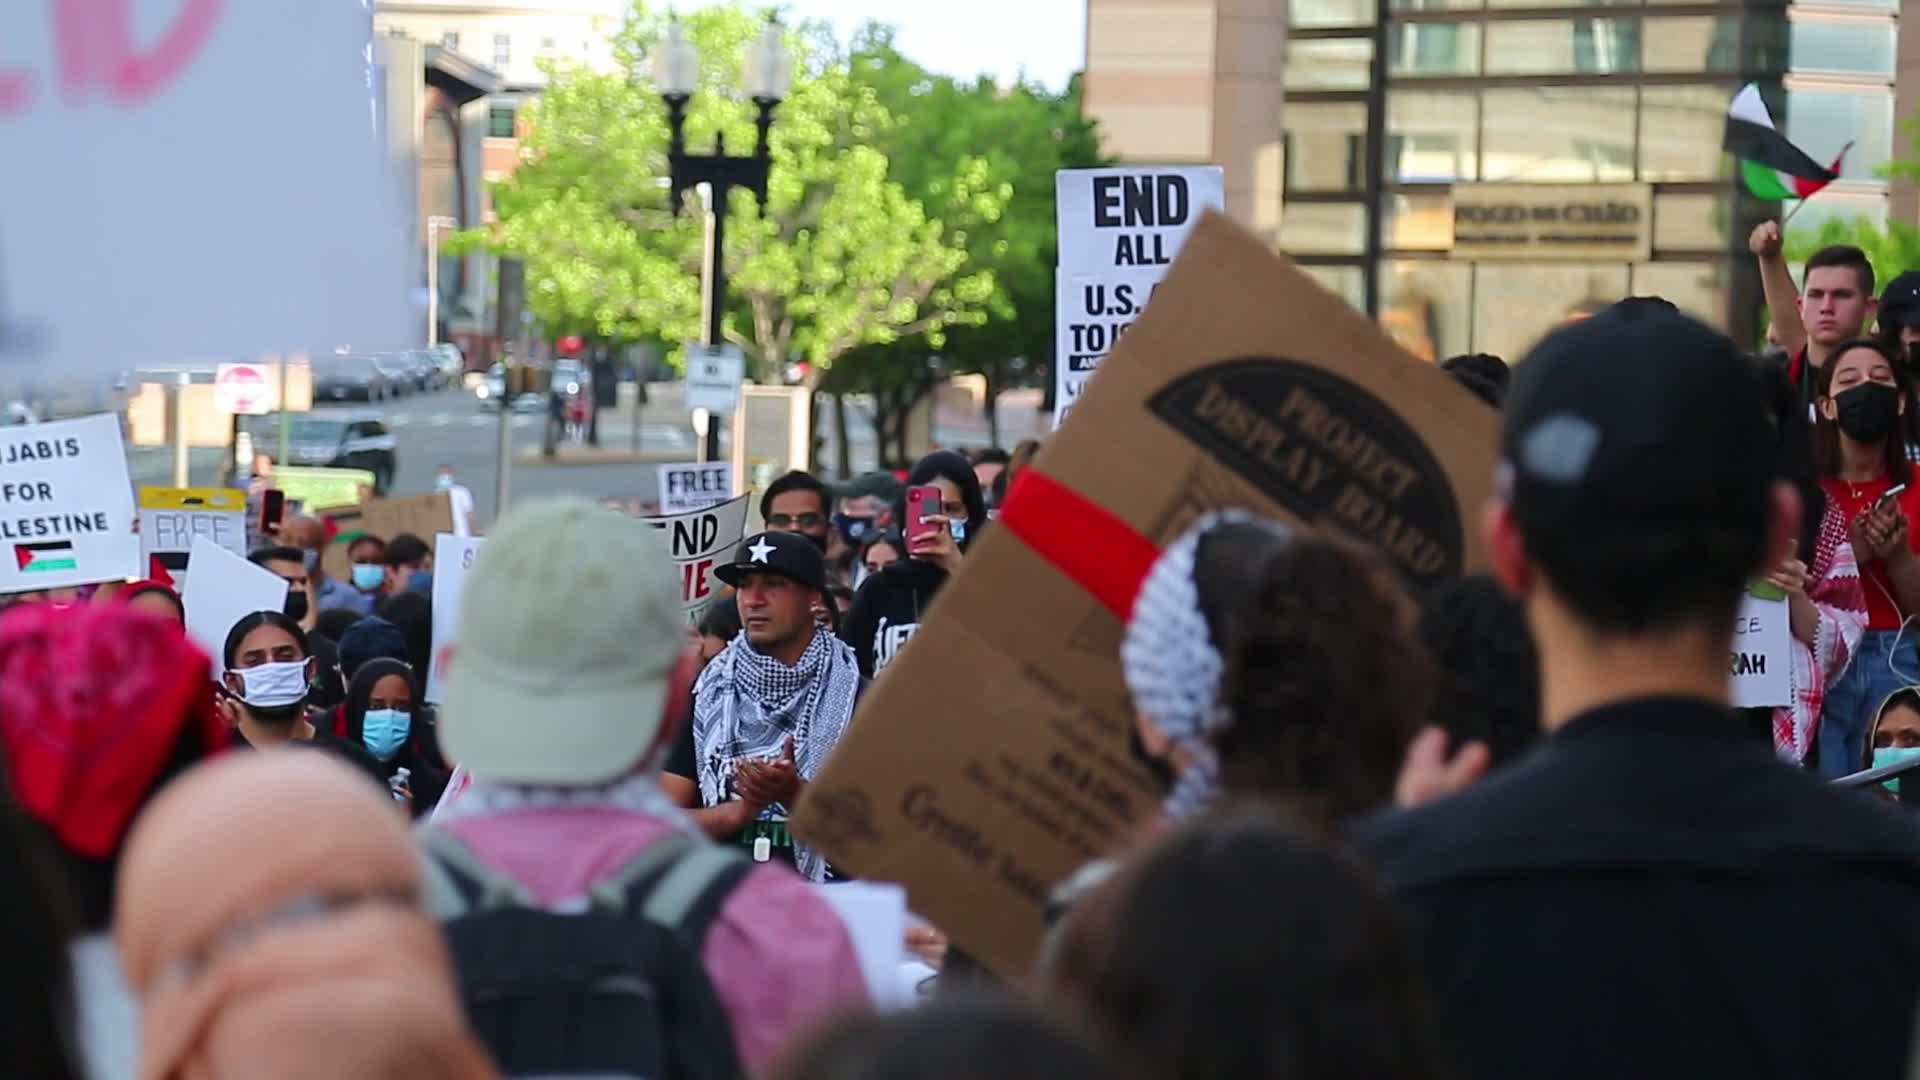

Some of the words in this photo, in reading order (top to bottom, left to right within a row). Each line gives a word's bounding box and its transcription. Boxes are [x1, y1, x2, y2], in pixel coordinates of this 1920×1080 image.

[1093, 175, 1189, 228] END
[1115, 234, 1170, 266] ALL
[1085, 284, 1141, 316] U.S.
[1069, 324, 1105, 352] TO
[0, 438, 80, 463] JABIS
[3, 482, 53, 502] FOR
[668, 469, 727, 495] FREE
[0, 512, 109, 538] LESTINE
